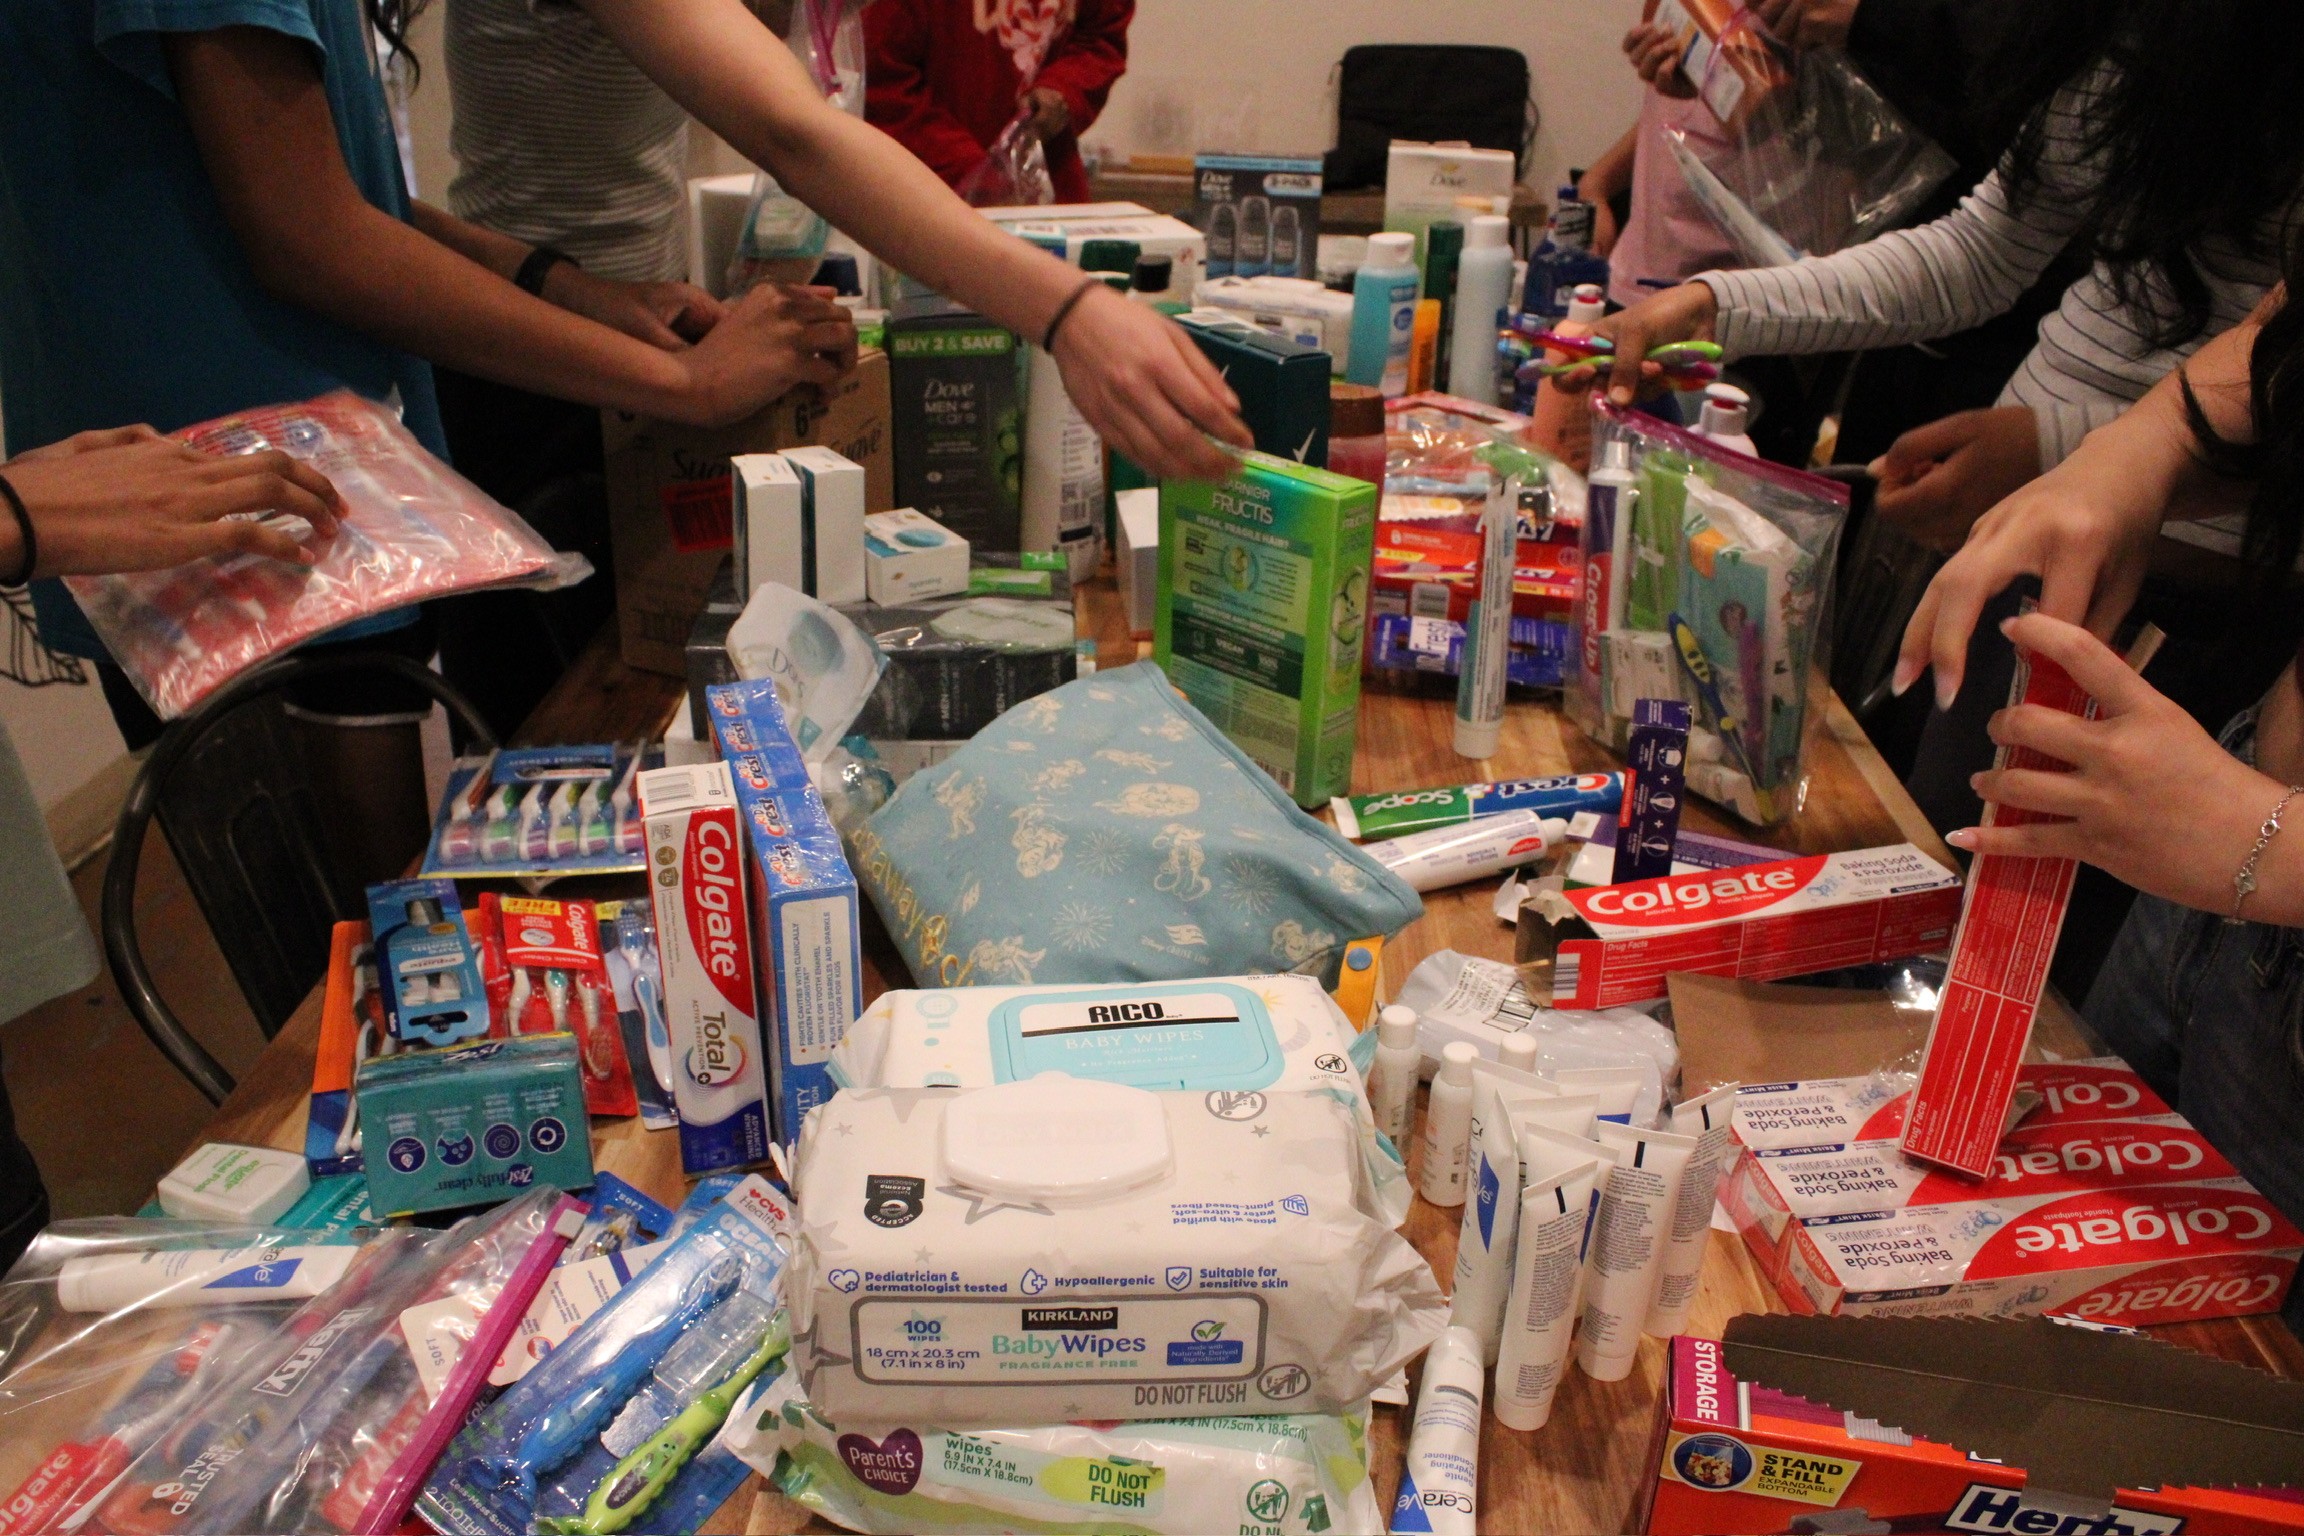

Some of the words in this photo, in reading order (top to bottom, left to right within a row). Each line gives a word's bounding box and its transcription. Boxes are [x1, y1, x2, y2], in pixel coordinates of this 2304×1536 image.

[933, 338, 944, 351] 2
[961, 336, 1005, 350] SAVE
[923, 377, 976, 400] Dove
[1211, 494, 1273, 525] FRUCTIS
[744, 755, 769, 790] Crest
[1500, 773, 1611, 799] Crest
[1363, 789, 1454, 815] Scope
[758, 798, 785, 837] Crest
[695, 821, 736, 977] Colgate
[1586, 868, 1797, 916] Colgate
[565, 903, 589, 951] Colgate
[1607, 940, 1626, 952] Drug
[1628, 940, 1649, 949] Facts
[795, 966, 803, 986] WITH
[833, 961, 841, 978] KIDS
[815, 976, 824, 1002] TOOTH
[834, 980, 842, 994] FOR
[1088, 1002, 1164, 1023] RICO
[805, 1016, 814, 1045] PROVEN
[1065, 1034, 1123, 1051] BABY
[1134, 1029, 1205, 1044] WIPES
[703, 1011, 732, 1073] Total
[1743, 1106, 1822, 1119] Peroxide
[1793, 1113, 1848, 1130] Baking
[1912, 1100, 1928, 1126] Facts
[1749, 1119, 1789, 1132] Soda
[1905, 1125, 1923, 1150] Drug
[1789, 1169, 1871, 1184] Peroxide
[1838, 1177, 1898, 1193] Baking
[1794, 1183, 1836, 1198] Soda
[739, 1195, 777, 1231] Health
[759, 1197, 786, 1222] CVS
[1205, 1201, 1275, 1210] plant-based
[1243, 1209, 1276, 1217] water
[2090, 1209, 2114, 1217] Fluoride
[871, 1213, 914, 1225] ACCEPTED
[1173, 1215, 1217, 1225] purified
[1219, 1216, 1244, 1224] with
[1246, 1217, 1277, 1225] Made
[1825, 1222, 1935, 1242] WHITENING
[2015, 1205, 2272, 1254] Colgate
[1840, 1238, 1924, 1254] Peroxide
[1844, 1255, 1887, 1270] Soda
[1889, 1249, 1953, 1266] Baking
[865, 1271, 947, 1283] Pediatrician
[950, 1271, 960, 1282] &
[1054, 1275, 1155, 1288] Hypoallergenic
[1199, 1267, 1254, 1279] Suitable
[1257, 1267, 1278, 1278] for
[865, 1283, 961, 1293] dermatologist
[964, 1283, 1008, 1293] tested
[1199, 1278, 1258, 1290] sensitive
[1261, 1277, 1288, 1289] skin
[2078, 1274, 2281, 1316] Colgate
[1027, 1310, 1114, 1322] KIRKLAND
[903, 1320, 941, 1335] 100
[425, 1338, 445, 1367] SOFT
[866, 1348, 883, 1358] 18
[885, 1350, 908, 1358] cm
[911, 1350, 920, 1358] x
[923, 1349, 954, 1359] 20.3
[957, 1350, 980, 1359] cm
[881, 1359, 906, 1369] (7.1
[908, 1359, 922, 1369] in
[924, 1360, 932, 1369] x
[935, 1359, 945, 1369] 8
[947, 1359, 966, 1370] in)
[999, 1359, 1094, 1370] FRAGRANCE
[1100, 1359, 1139, 1369] FREE
[1694, 1340, 1720, 1421] STORAGE
[1134, 1385, 1158, 1406] DO
[1162, 1384, 1196, 1405] NOT
[1198, 1383, 1247, 1404] FLUSH
[1197, 1418, 1211, 1428] IN
[1213, 1417, 1254, 1433] (17.5cm
[1256, 1422, 1265, 1433] X
[1268, 1423, 1308, 1443] 18.8cm)
[849, 1445, 915, 1469] Parent's
[945, 1437, 992, 1457] wipes
[184, 1443, 226, 1485] SEAL
[944, 1450, 961, 1462] 6.9
[963, 1452, 975, 1463] IN
[977, 1455, 985, 1466] X
[987, 1457, 1002, 1469] 7.4
[1005, 1461, 1016, 1472] IN
[1422, 1452, 1475, 1469] Conditioner
[1430, 1460, 1475, 1480] Hydrating
[1763, 1453, 1843, 1476] STAND
[171, 1447, 245, 1514] TRUSTED
[864, 1468, 909, 1485] CHOICE
[943, 1460, 981, 1476] (17.5cm
[984, 1467, 992, 1478] X
[994, 1468, 1034, 1486] 18.8cm)
[1088, 1464, 1113, 1484] DO
[1116, 1471, 1151, 1490] NOT
[1445, 1470, 1475, 1487] Gentle
[1761, 1465, 1778, 1478] &
[1781, 1467, 1826, 1485] FILL
[1757, 1483, 1809, 1497] BOTTOM
[1758, 1476, 1836, 1495] EXPANDABLE
[1090, 1486, 1146, 1508] FLUSH
[1397, 1491, 1473, 1515] CeraVe
